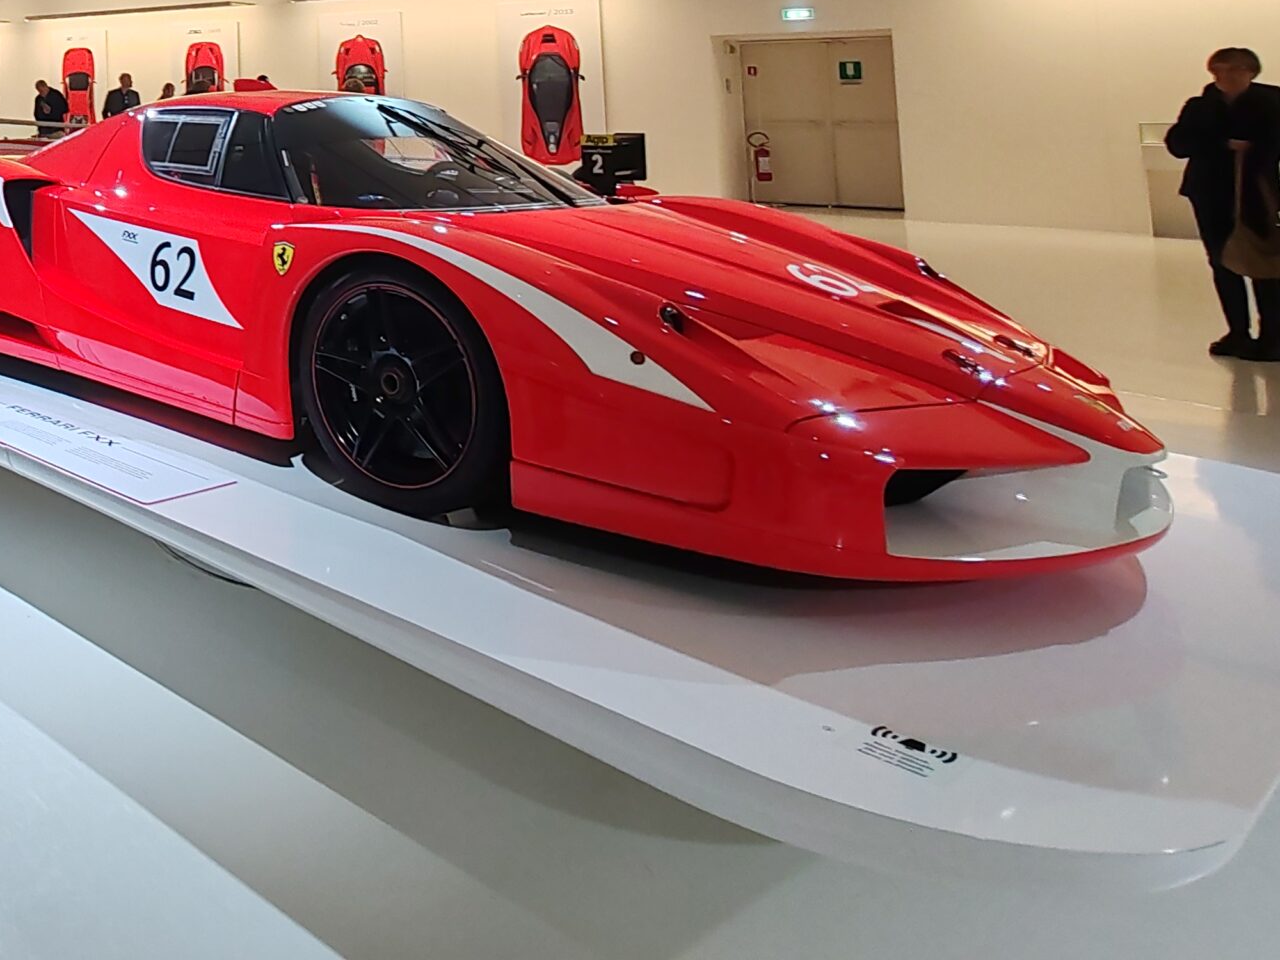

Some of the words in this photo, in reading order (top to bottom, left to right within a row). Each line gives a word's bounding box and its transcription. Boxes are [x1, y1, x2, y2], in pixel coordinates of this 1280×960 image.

[553, 8, 574, 16] 2013
[585, 135, 609, 145] Agip
[591, 154, 604, 174] 2
[121, 230, 138, 241] FXX
[150, 241, 196, 301] 62
[786, 262, 879, 297] 62
[6, 404, 81, 431] FERRARI
[77, 429, 122, 447] FXX
